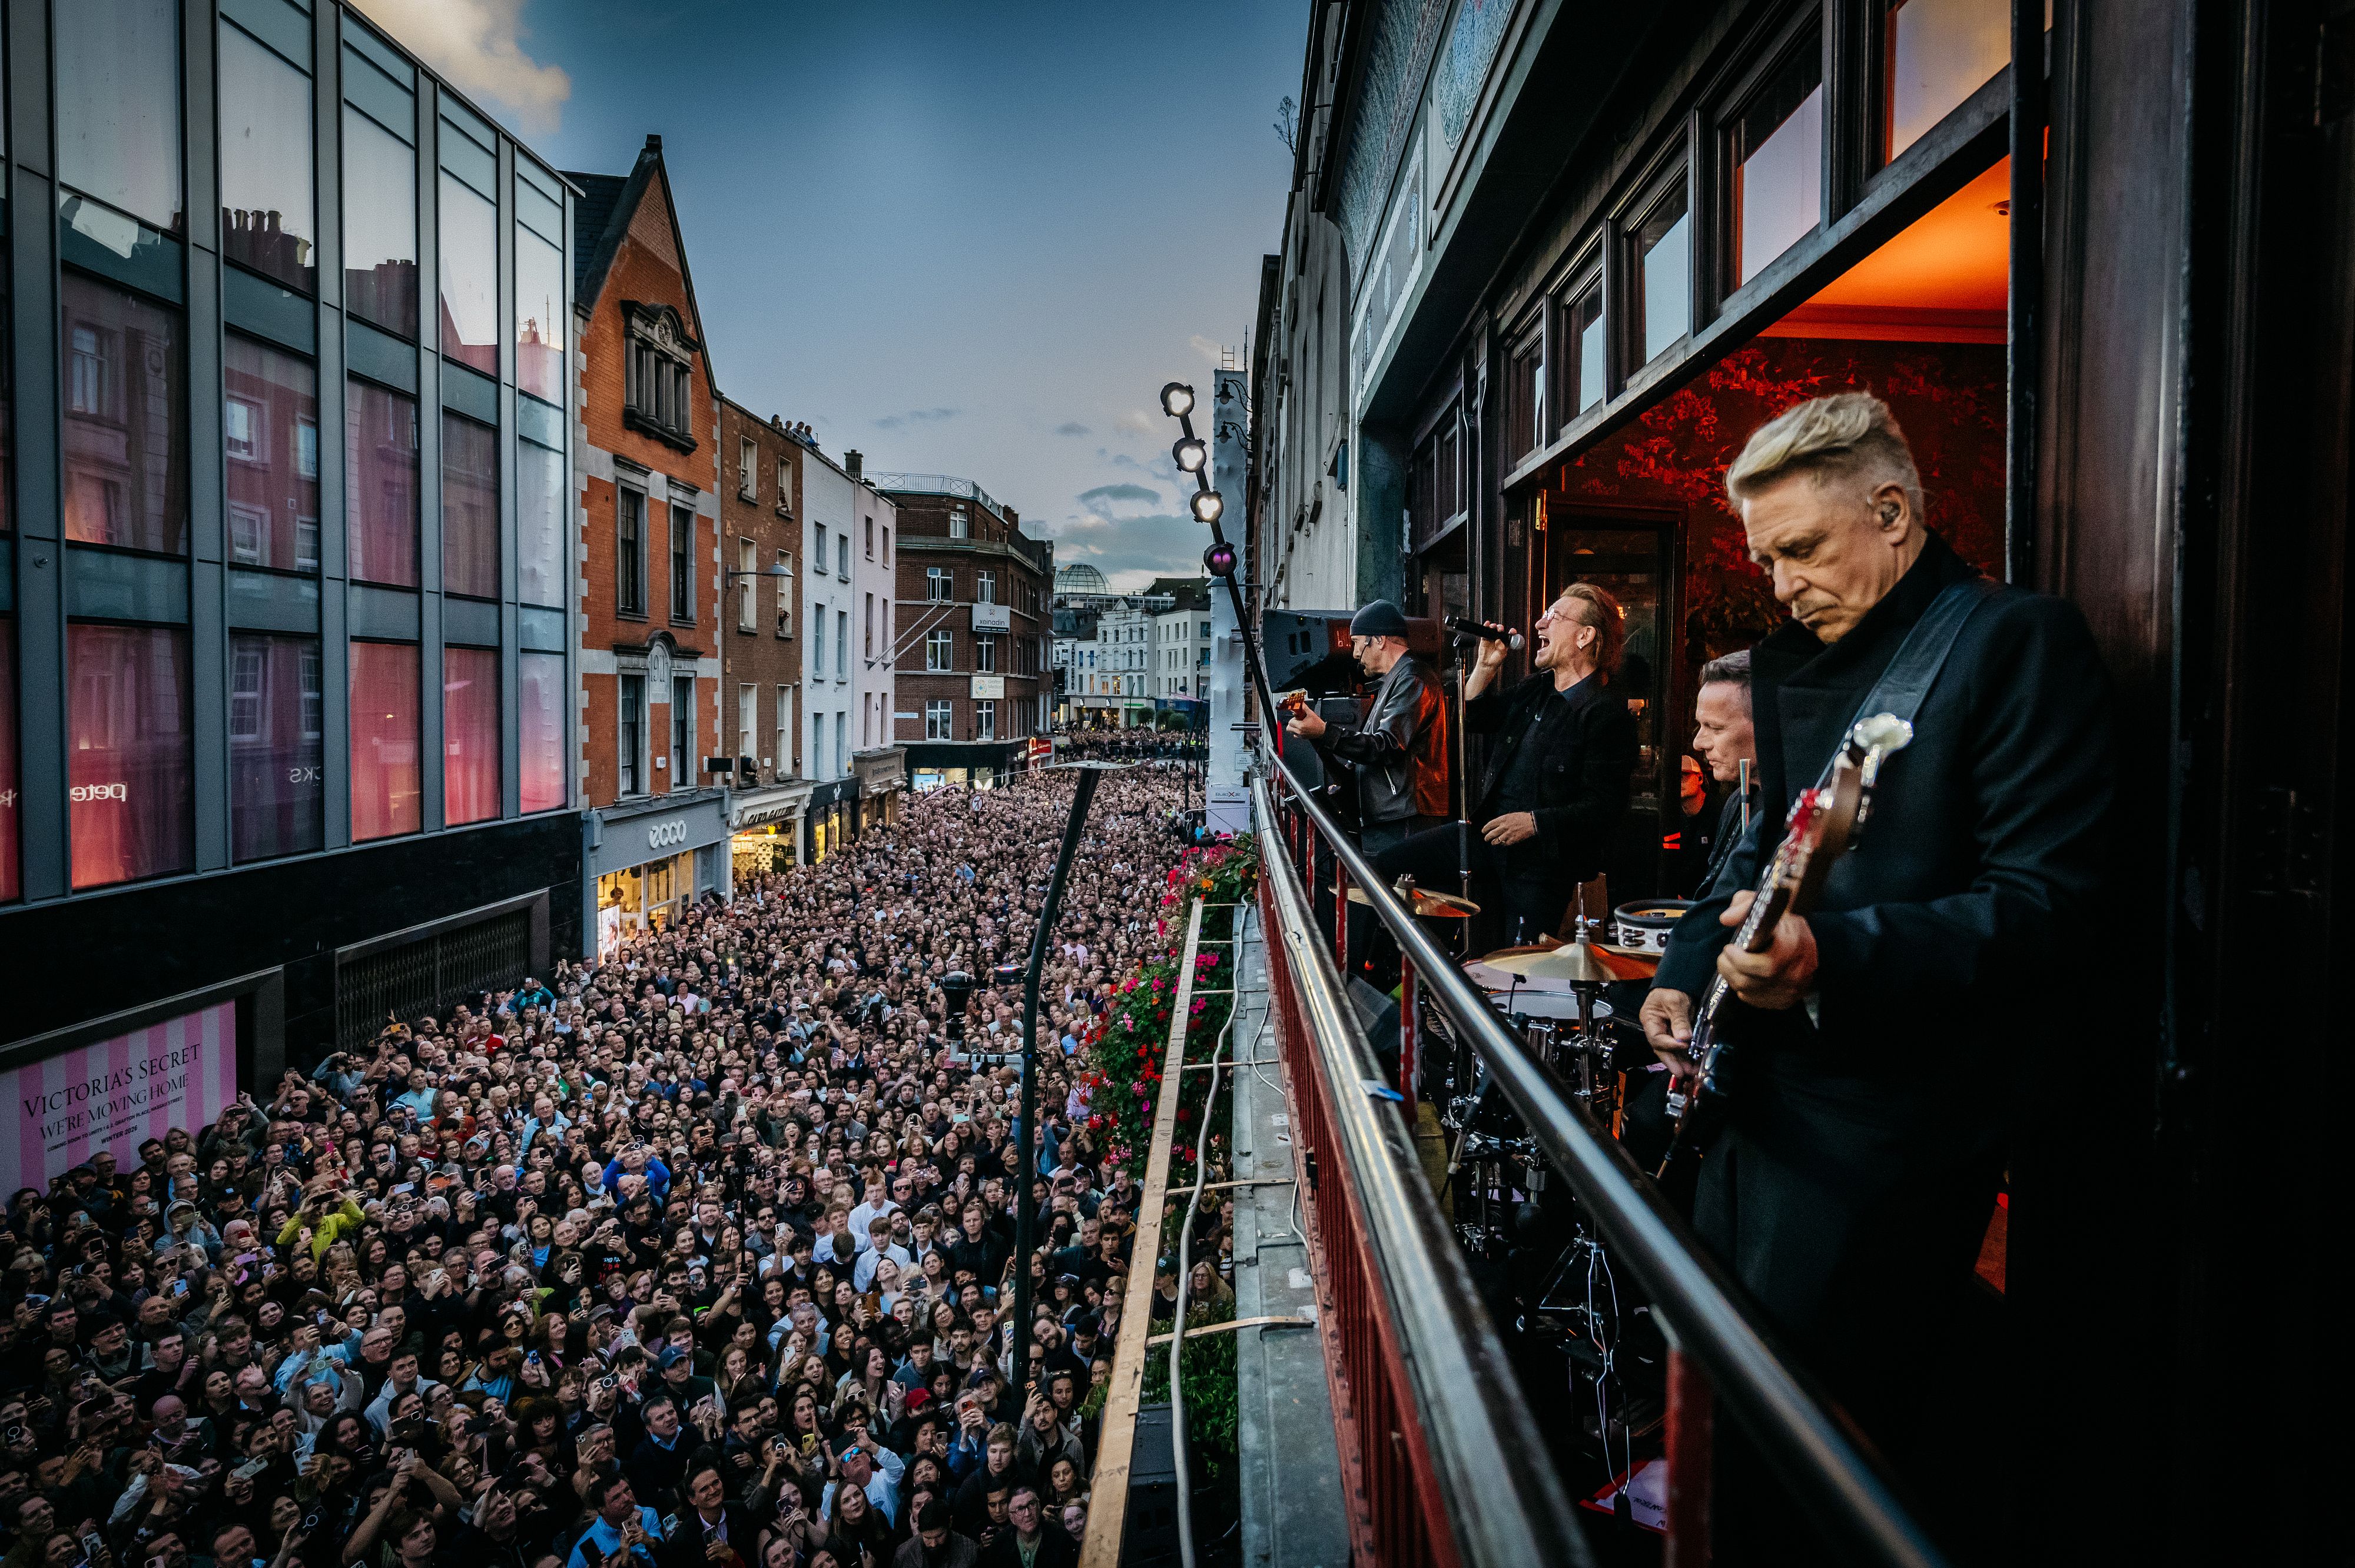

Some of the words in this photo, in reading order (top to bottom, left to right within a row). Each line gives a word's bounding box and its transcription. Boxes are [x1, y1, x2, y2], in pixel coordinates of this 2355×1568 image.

[649, 820, 686, 848] ecco
[24, 1067, 132, 1118] VICTORIA'S
[139, 1044, 200, 1079] SECRET
[39, 1112, 85, 1140] WE'RE
[88, 1089, 147, 1123] MOVING
[150, 1073, 189, 1099] HOME
[101, 1130, 124, 1145] WINTER
[124, 1125, 138, 1135] 2026
